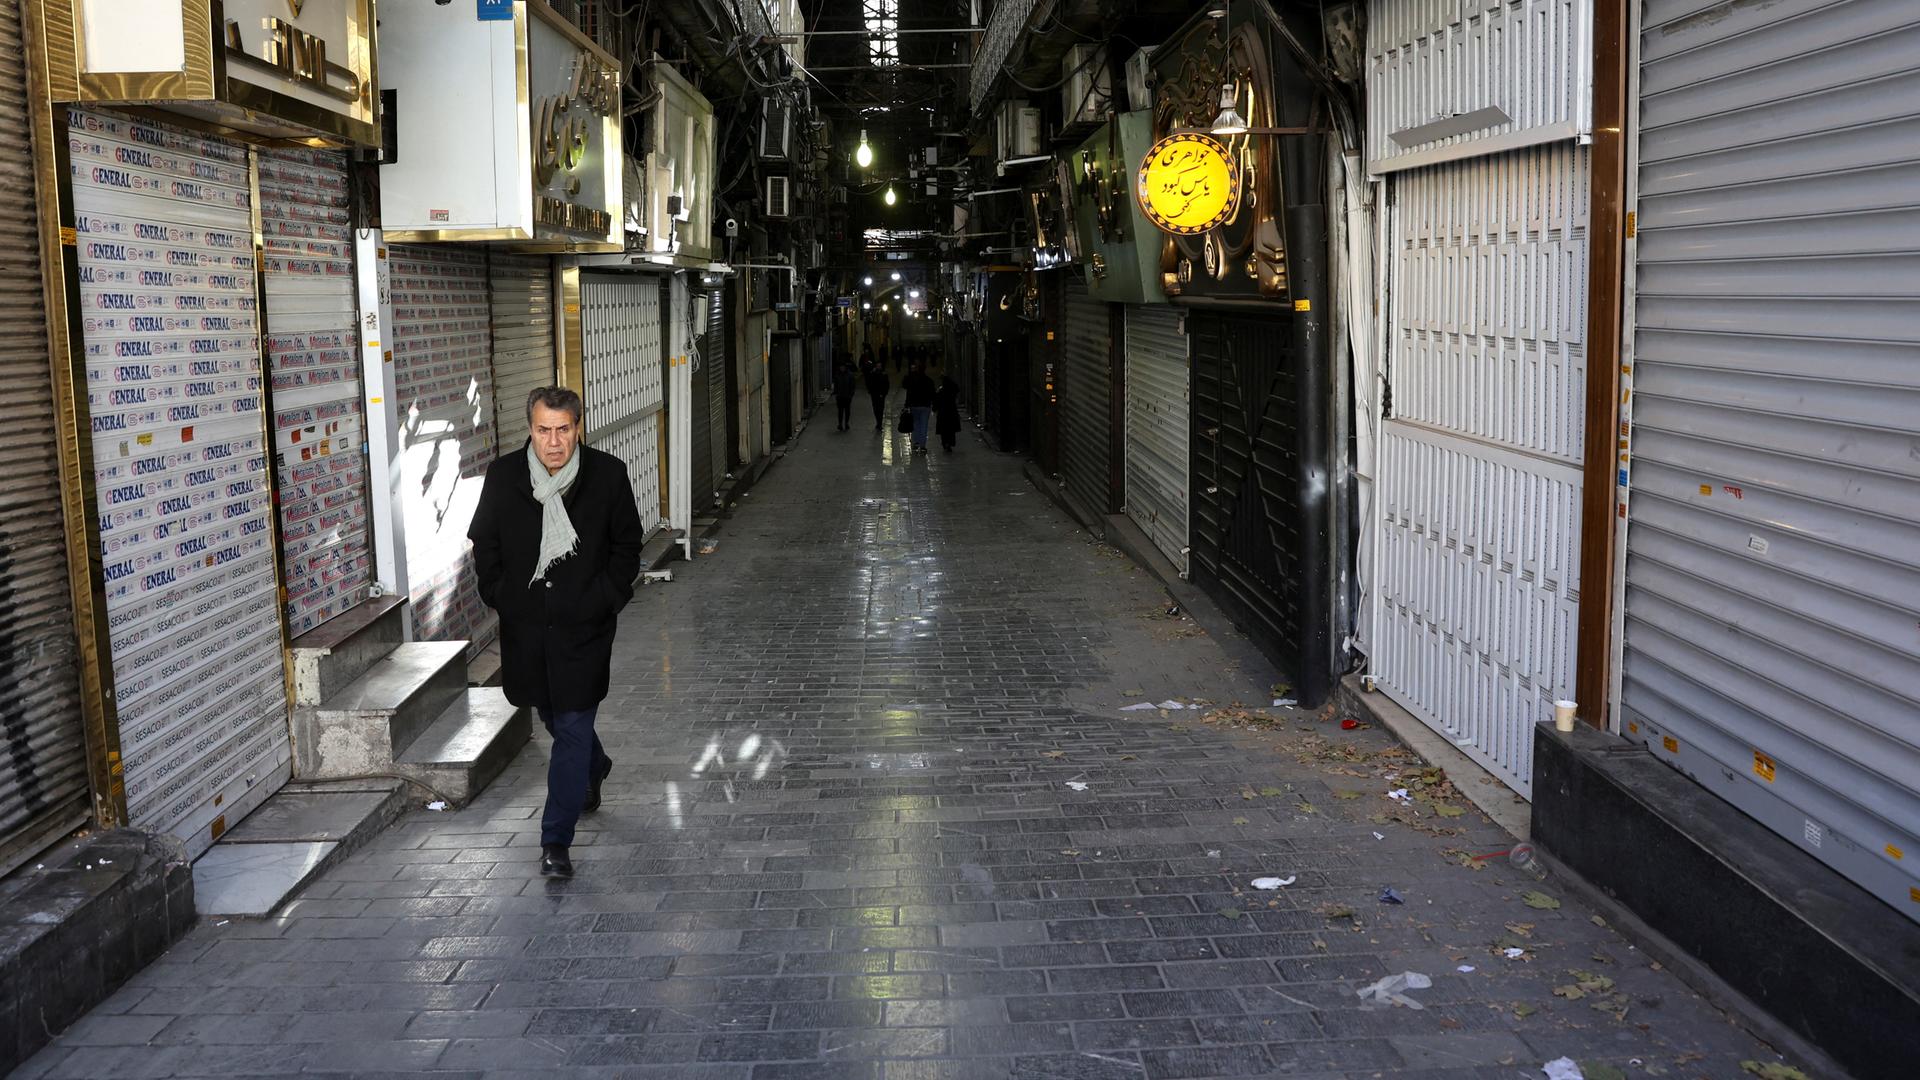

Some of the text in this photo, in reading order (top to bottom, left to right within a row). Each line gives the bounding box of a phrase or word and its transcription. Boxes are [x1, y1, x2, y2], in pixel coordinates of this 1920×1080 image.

[130, 126, 165, 147] GENERAL
[115, 147, 219, 181] GENERAL GENERAL
[1162, 148, 1210, 167] جواهری
[92, 167, 203, 200] GENERAL GENERAL
[1161, 165, 1210, 197] یاس کبود
[134, 223, 234, 248] GENERAL GENERAL
[87, 243, 126, 261] GENERAL
[166, 250, 198, 267] GENERAL
[138, 270, 173, 287] GENERAL
[208, 275, 237, 290] GENERAL
[97, 293, 136, 309] GENERAL
[174, 296, 206, 310] GENERAL
[128, 317, 230, 332] GENERAL GENERAL
[114, 339, 220, 357] GENERAL GENERAL
[114, 360, 219, 383] GENERAL GENERAL
[109, 388, 146, 406] GENERAL
[184, 381, 215, 398] GENERAL
[90, 397, 258, 432] ENERAL GENERAL GENERAL
[131, 442, 231, 475] GENERAL GENERAL
[105, 483, 145, 505] GENERAL
[184, 468, 216, 487] GENERAL
[156, 480, 254, 516] GENERAL GENERAL
[222, 499, 250, 519] GENERAL
[174, 535, 207, 558] GENERAL
[239, 517, 266, 537] GENERAL
[110, 609, 138, 628] SESACO
[195, 577, 218, 594] SESACO
[231, 562, 252, 579] SESACO
[140, 567, 176, 591] GENERAL
[113, 632, 140, 653] SESACO
[157, 614, 181, 633] SESACO
[197, 597, 219, 615] SESACO
[232, 583, 253, 600] SESACO
[133, 648, 160, 669] SESACO
[176, 631, 200, 649] SESACO
[214, 614, 236, 631] SESACO
[117, 680, 144, 702] SESACO
[161, 660, 186, 679] SESACO
[200, 641, 223, 660] SESACO
[235, 624, 256, 640] SESACO
[158, 684, 183, 705] SESACO
[198, 664, 220, 684] SESACO
[135, 720, 161, 743] SESACO
[178, 697, 201, 718] SESACO
[215, 677, 236, 696] SESACO
[124, 752, 148, 774] ESACO
[164, 729, 189, 749] SESACO
[204, 699, 226, 720] SESACO
[155, 757, 181, 780] SESACO
[196, 733, 219, 752] SESACO
[232, 710, 253, 729] SESACO
[163, 775, 188, 799] SESACO
[202, 750, 225, 772] SESACO
[171, 794, 196, 818] SESACO
[210, 767, 233, 789] SESACO
